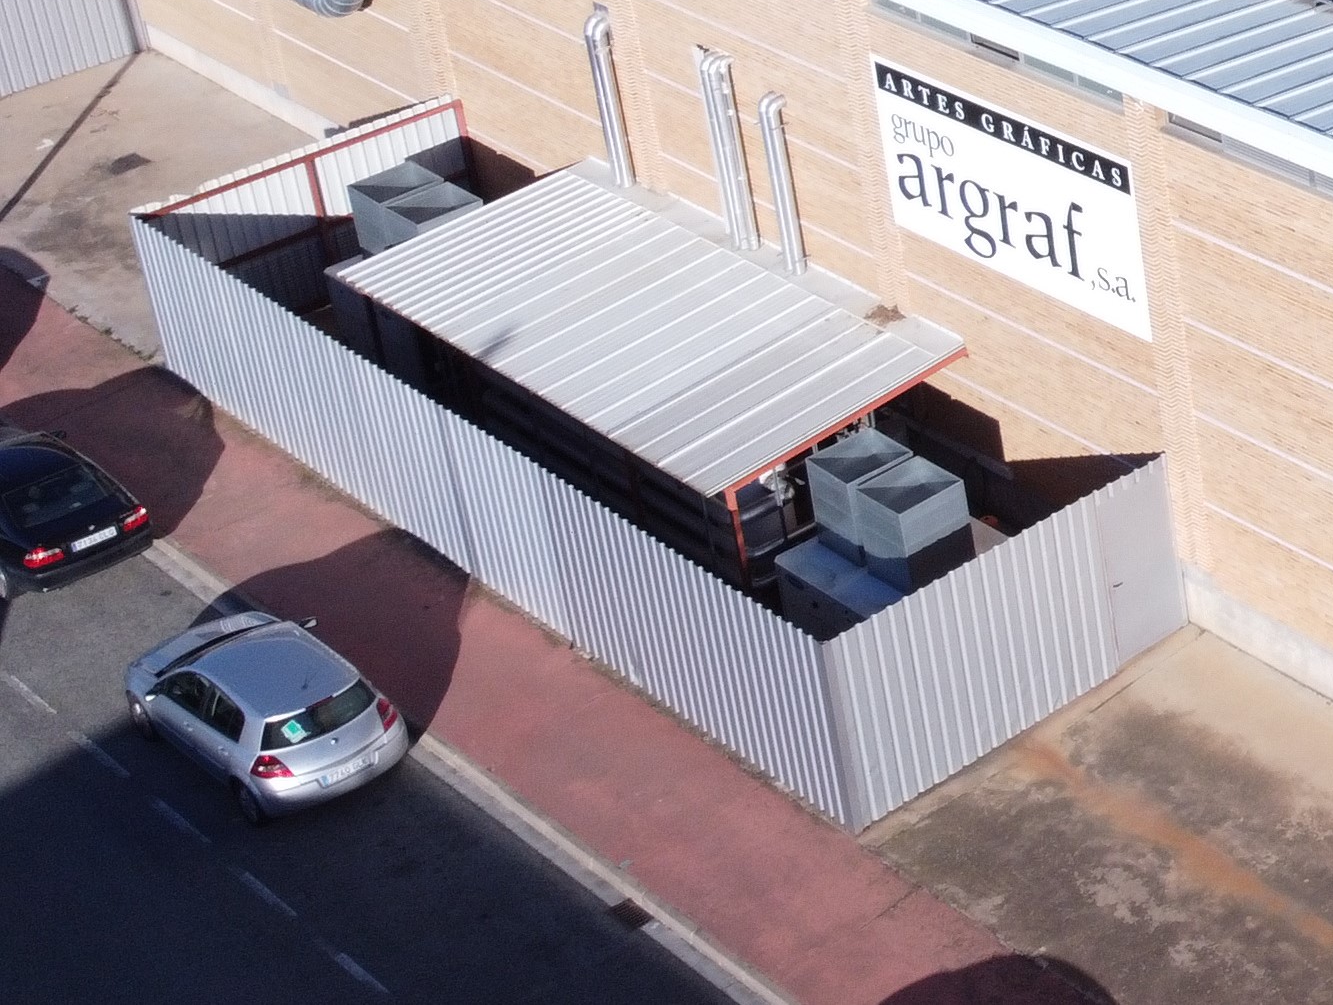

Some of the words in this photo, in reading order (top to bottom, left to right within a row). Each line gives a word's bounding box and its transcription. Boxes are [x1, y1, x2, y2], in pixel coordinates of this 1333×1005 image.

[884, 72, 966, 121] ARTES
[980, 112, 1123, 189] GRÁFICAS
[891, 112, 955, 158] grupo
[896, 152, 1085, 282] argraf
